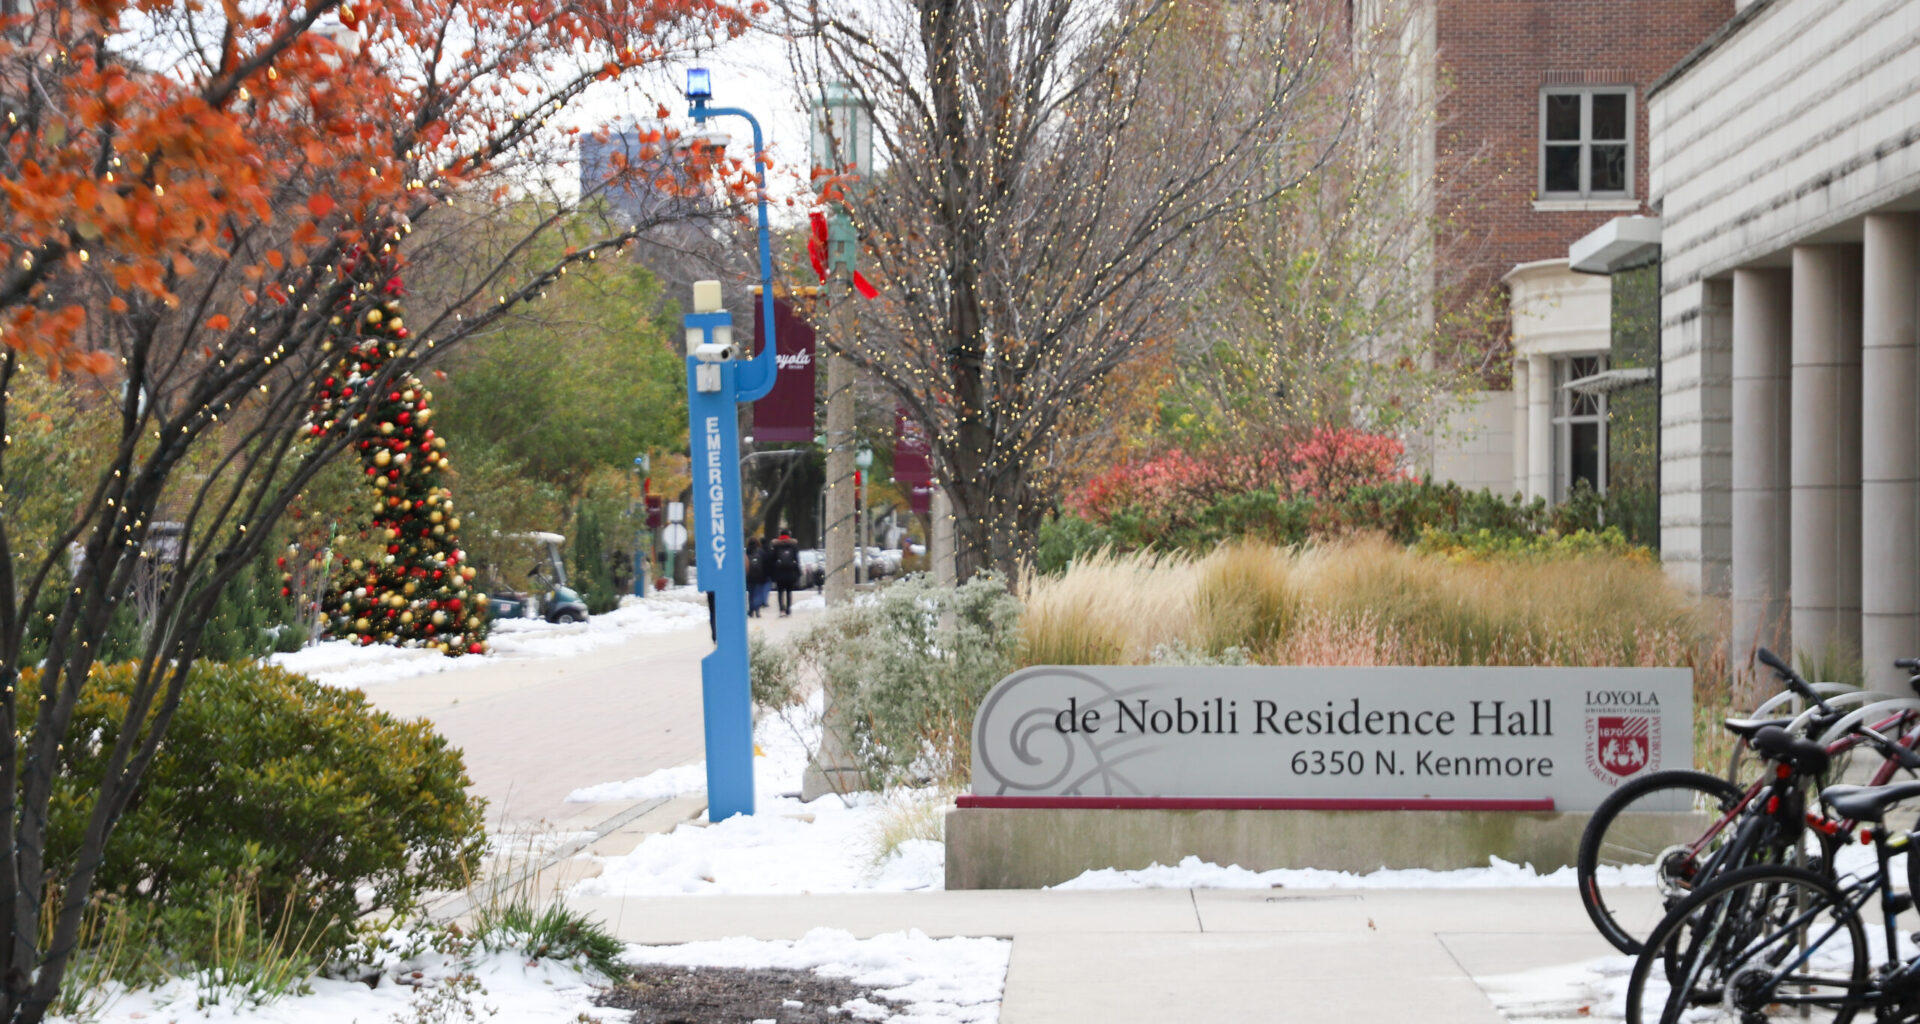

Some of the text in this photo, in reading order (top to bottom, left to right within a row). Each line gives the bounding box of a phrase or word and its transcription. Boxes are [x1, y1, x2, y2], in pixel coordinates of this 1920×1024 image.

[775, 347, 811, 369] oyola
[706, 416, 726, 570] EMERGENCY
[1585, 690, 1660, 706] LOYOLA
[1054, 697, 1554, 737] de Nobili Residence Hall
[1599, 727, 1623, 737] 1870
[1290, 750, 1554, 777] 6350 N. Kenmore
